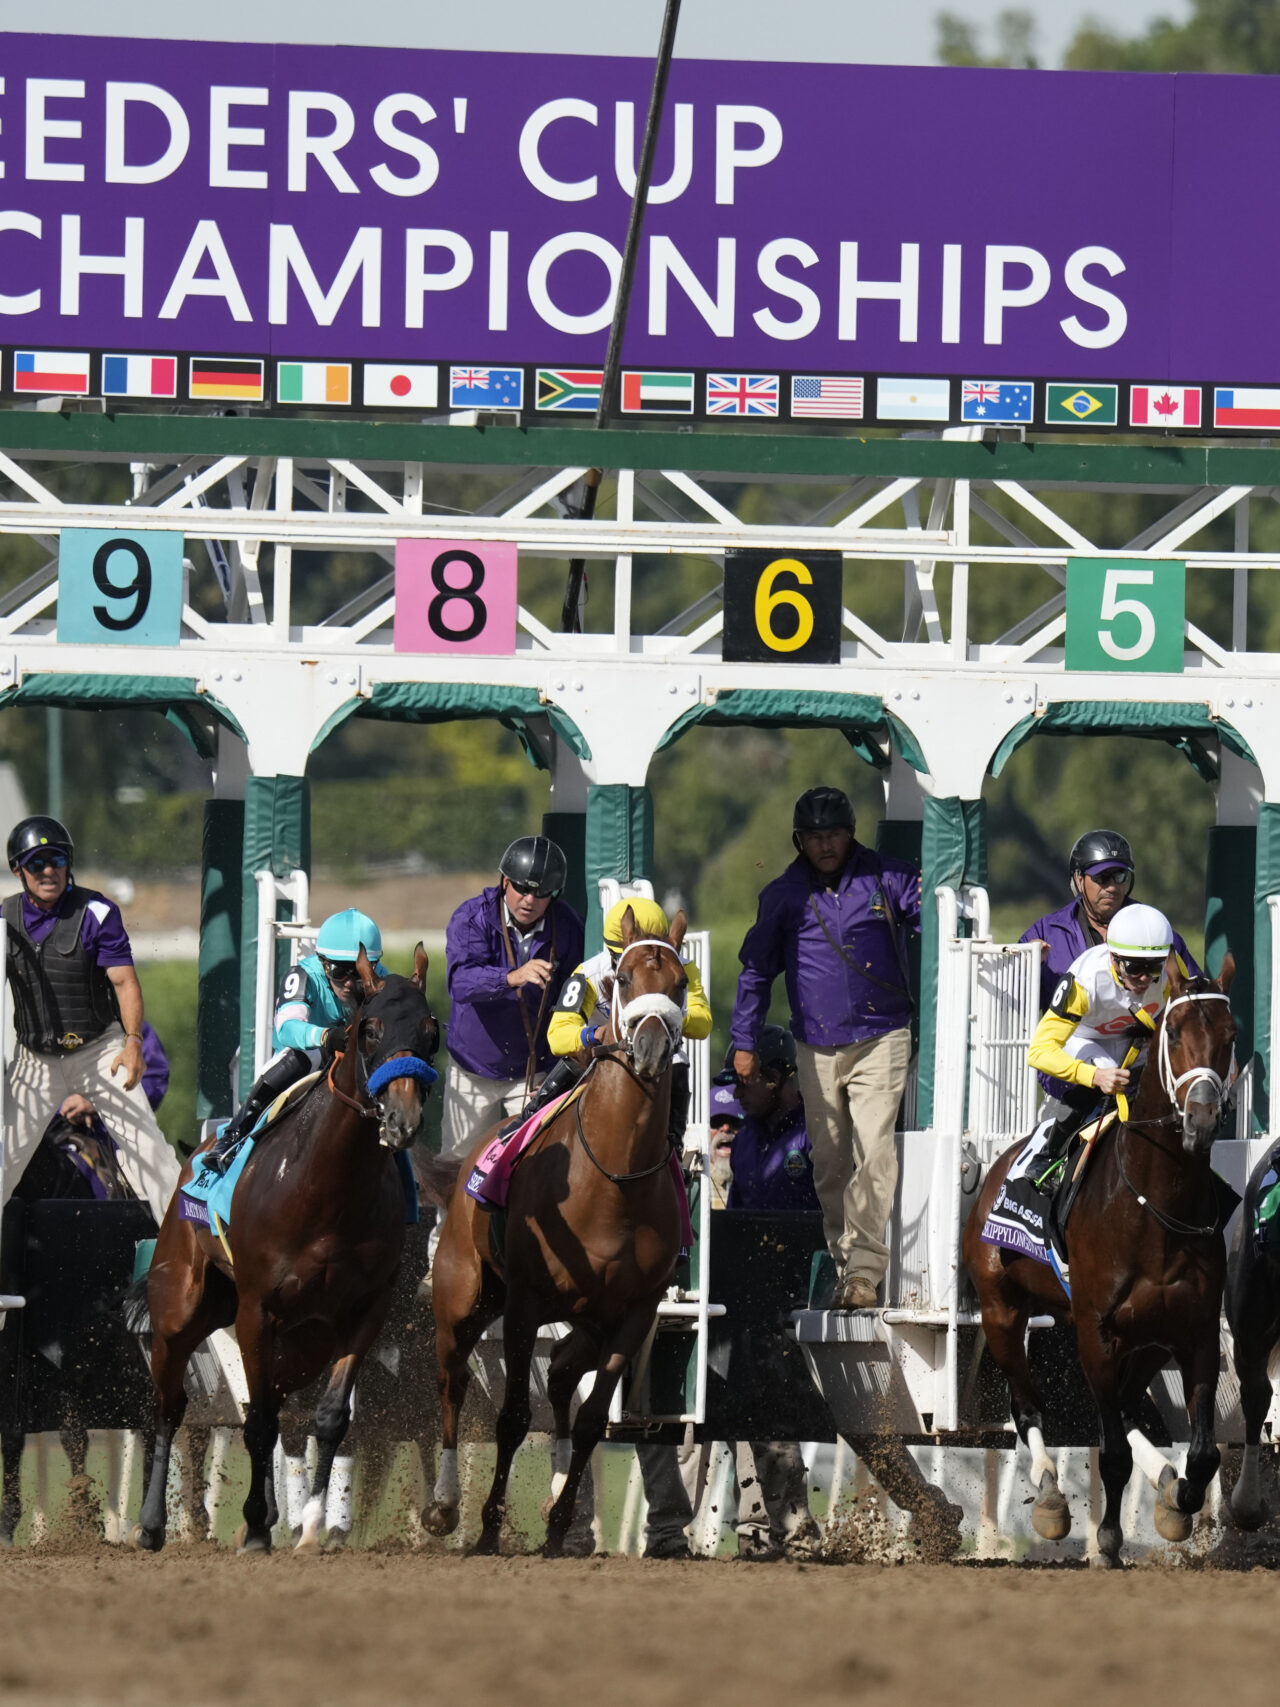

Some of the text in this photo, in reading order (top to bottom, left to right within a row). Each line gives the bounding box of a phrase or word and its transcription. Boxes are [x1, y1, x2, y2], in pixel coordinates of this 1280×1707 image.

[0, 78, 783, 205] EDERS' CUP
[0, 210, 1128, 349] CHAMPIONSHIPS
[93, 539, 152, 632] 9
[427, 549, 487, 642] 8
[754, 558, 814, 652] 6
[1097, 569, 1156, 661] 5
[284, 973, 300, 999] 9
[562, 981, 581, 1007] 8
[1052, 980, 1068, 1007] 6
[1003, 1197, 1018, 1214] BIG
